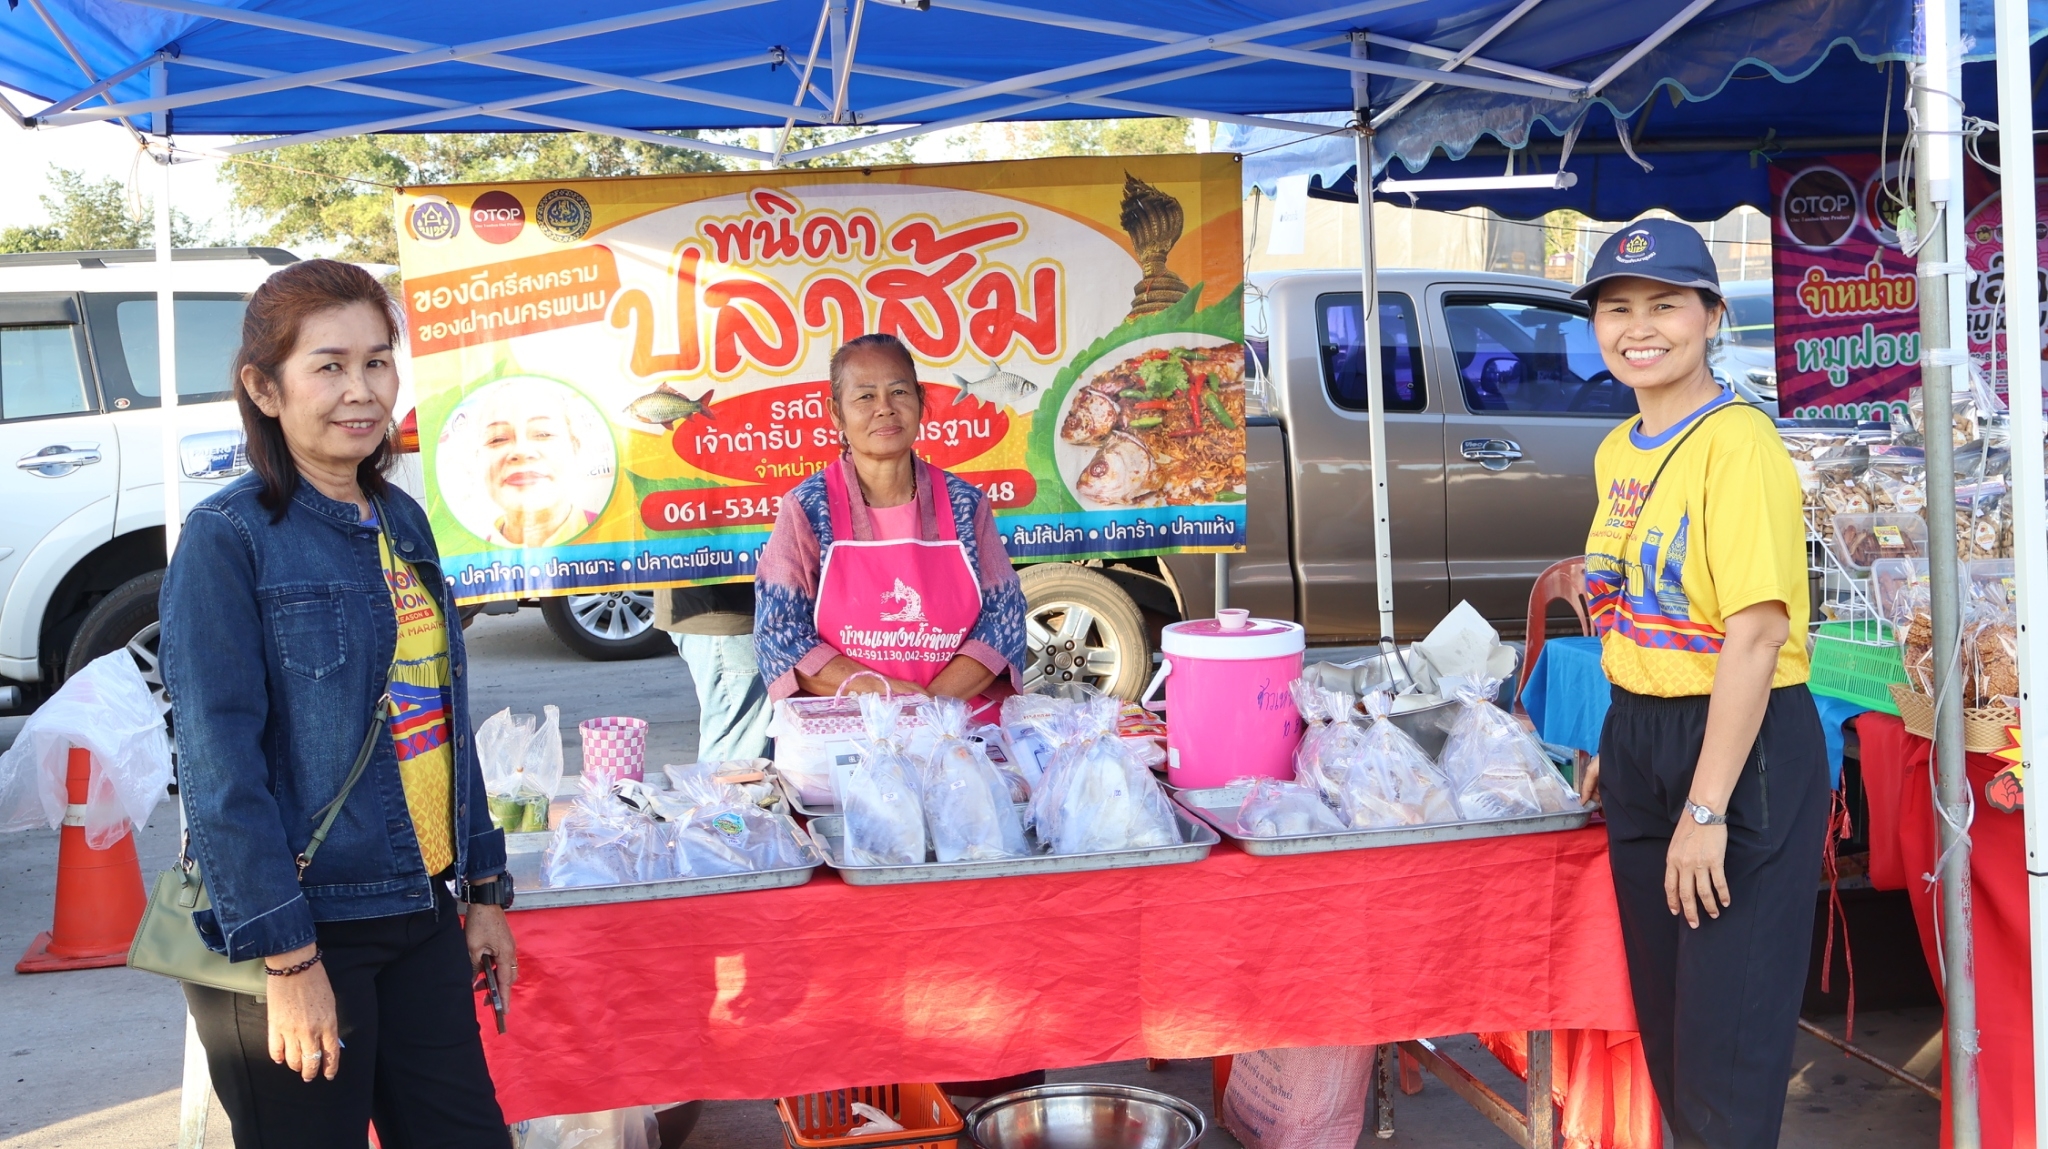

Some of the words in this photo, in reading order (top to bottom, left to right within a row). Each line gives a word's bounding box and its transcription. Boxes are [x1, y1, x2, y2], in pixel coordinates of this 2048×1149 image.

[474, 208, 521, 222] OTOP
[1790, 195, 1850, 214] OTOP
[704, 191, 878, 263] พนิดา
[413, 264, 599, 313] ของดีศรีสงคราม
[610, 220, 1057, 377] ปลาส้ม
[1803, 268, 1915, 312] จำหน่าย
[418, 289, 606, 342] ของฝากนครพนม
[1796, 324, 1921, 384] หมูฝอย
[771, 391, 823, 421] รสดี
[695, 422, 802, 455] เจ้าตำรับ
[755, 455, 828, 479] จำหน่าย
[461, 563, 525, 587] ปลาโจก
[545, 556, 615, 578] ปลาเผาะ
[637, 546, 733, 572] ปลาตะเพียน
[1013, 525, 1083, 546] ส้มไส้ปลา
[1104, 519, 1155, 541] ปลาร้า
[1171, 514, 1235, 538] ปลาแห้ง
[399, 612, 423, 624] EASON
